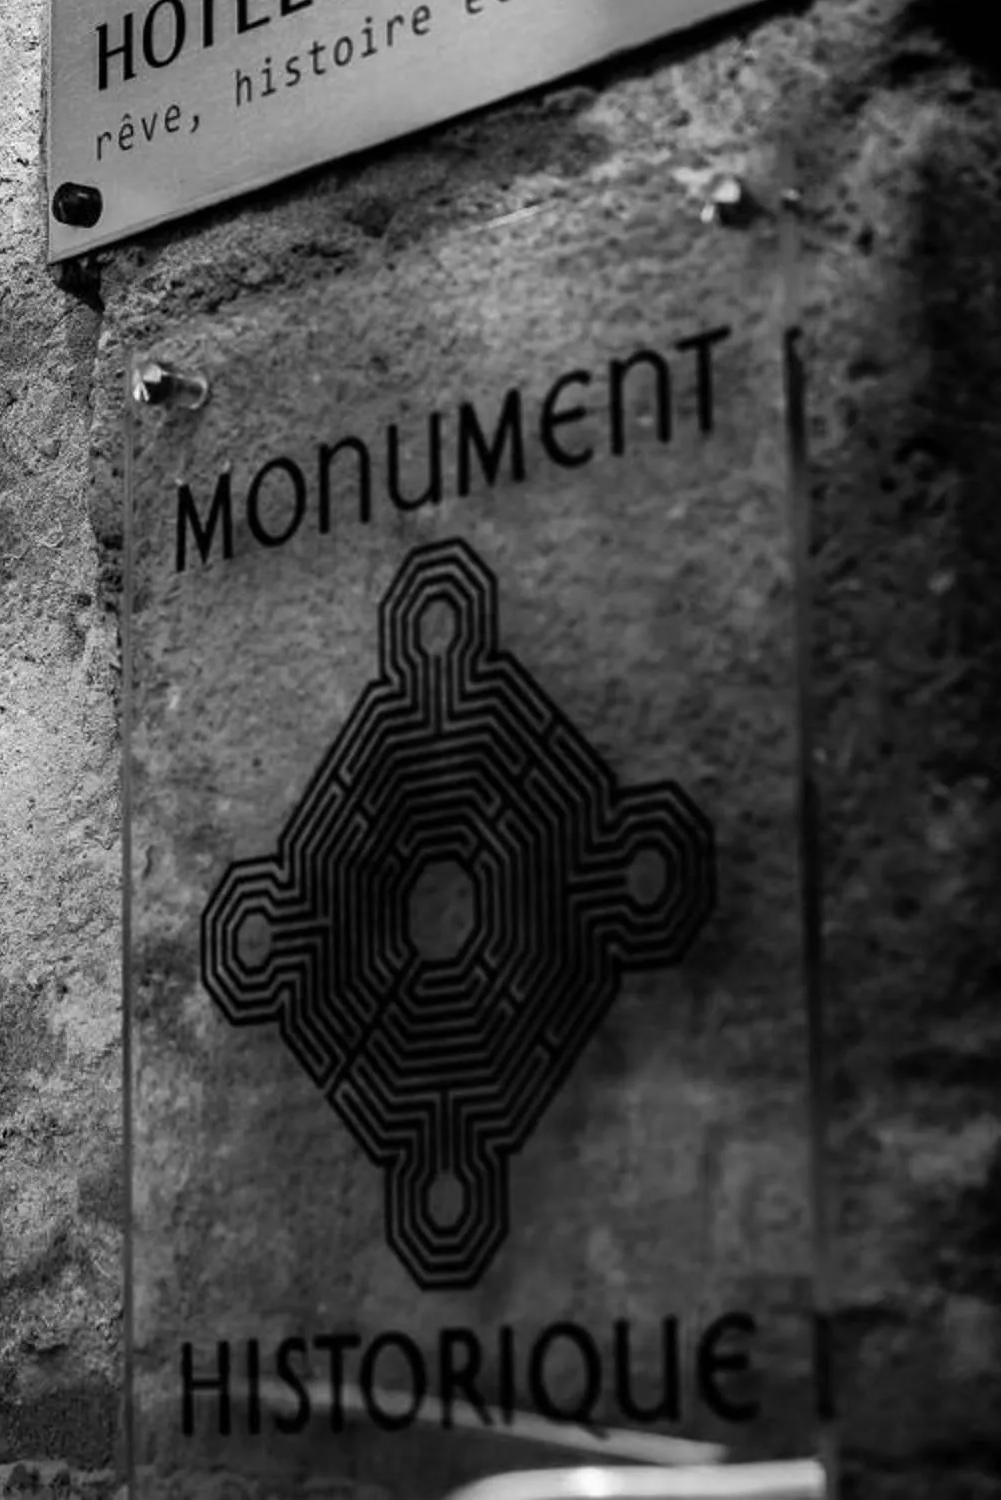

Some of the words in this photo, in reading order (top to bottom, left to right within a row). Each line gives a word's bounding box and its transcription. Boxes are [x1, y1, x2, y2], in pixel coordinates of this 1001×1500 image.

[94, 102, 203, 162] rêve,
[234, 5, 432, 108] histoire
[175, 325, 732, 572] MONUMENT
[180, 1311, 760, 1440] HISTORIQUE
